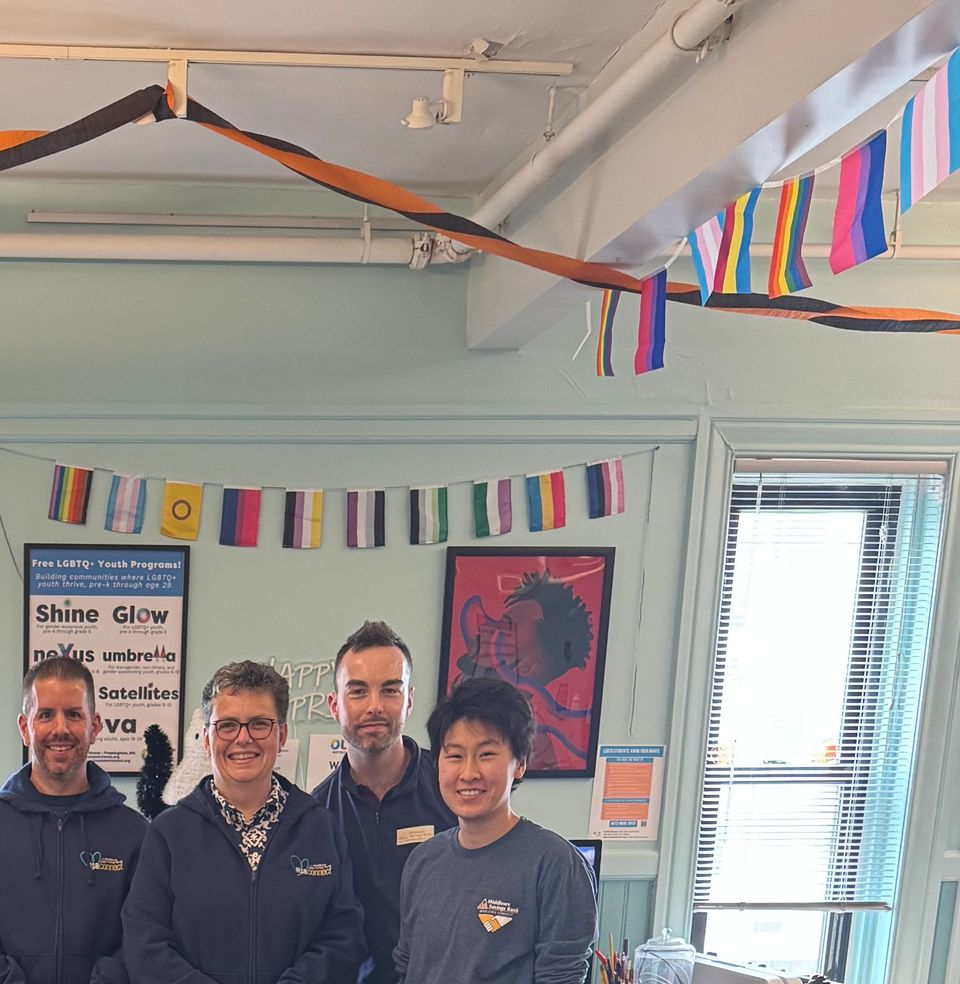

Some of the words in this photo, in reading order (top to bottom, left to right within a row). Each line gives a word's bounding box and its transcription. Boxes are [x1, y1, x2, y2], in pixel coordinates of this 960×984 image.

[32, 560, 54, 568] Free
[57, 560, 94, 569] LGBTQ+
[98, 560, 128, 568] Youth
[130, 560, 181, 570] Programs!
[35, 573, 67, 581] Building
[146, 574, 176, 582] LGBTQ+
[37, 581, 60, 589] youth
[89, 581, 110, 589] pre-k
[113, 581, 142, 589] through
[36, 600, 99, 623] Shine
[112, 605, 169, 624] Glow
[99, 683, 179, 700] Satellites
[104, 718, 137, 734] va
